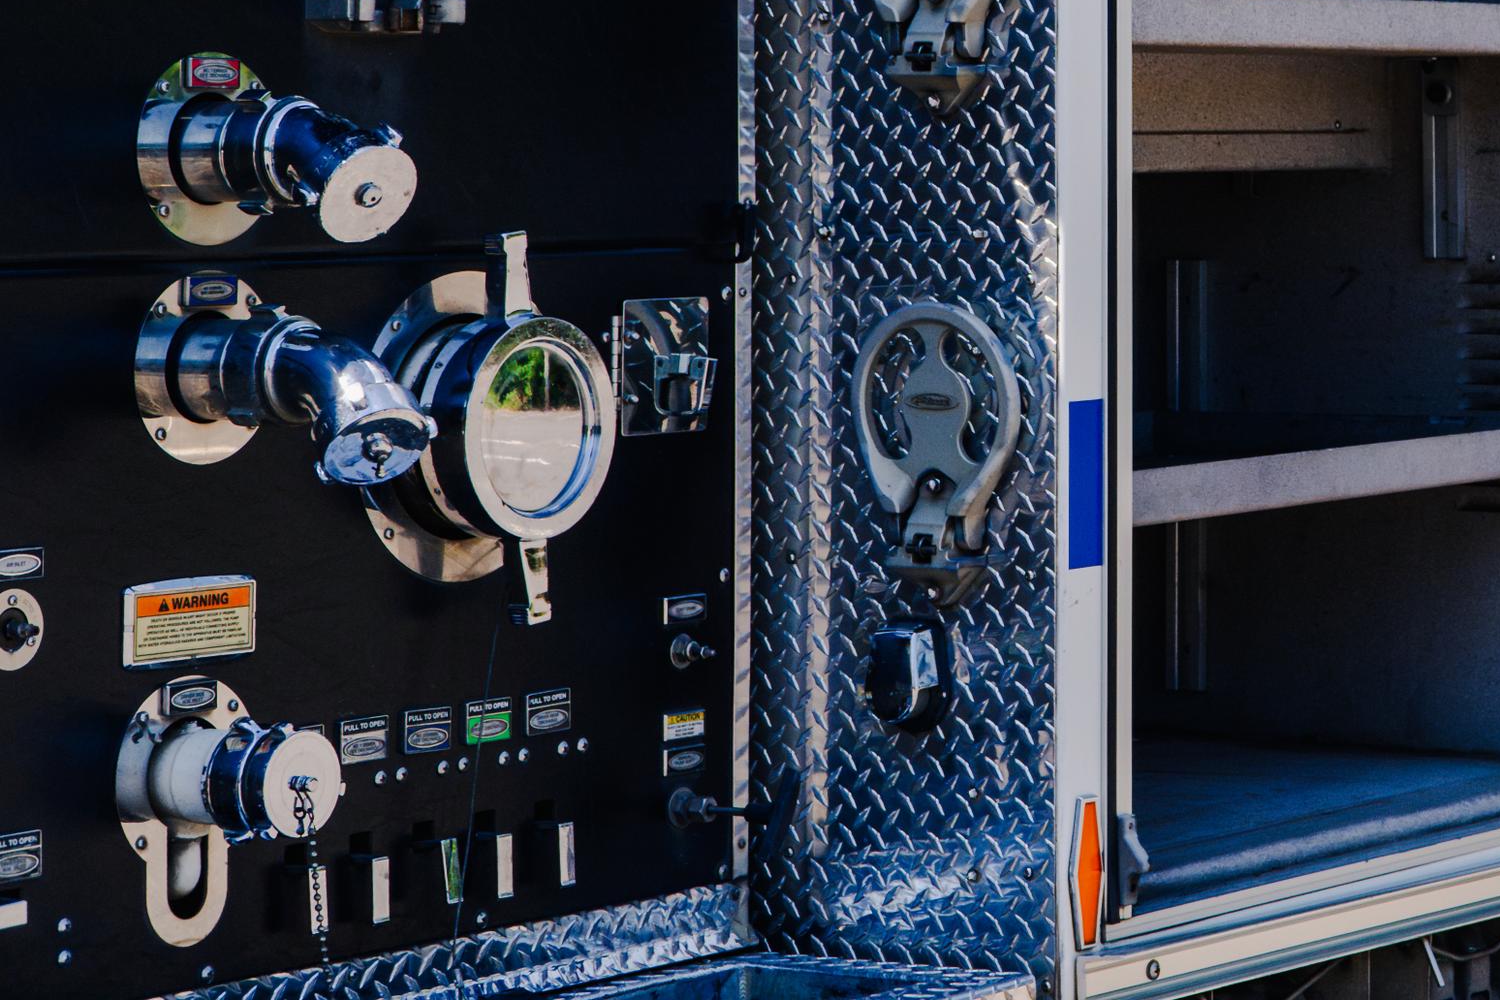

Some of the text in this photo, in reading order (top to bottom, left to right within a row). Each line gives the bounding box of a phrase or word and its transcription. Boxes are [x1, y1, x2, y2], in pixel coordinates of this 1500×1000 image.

[172, 592, 229, 610] WARNING
[551, 692, 567, 700] OPEN
[493, 700, 509, 709] OPEN
[408, 714, 423, 722] PULL
[432, 711, 448, 719] OPEN
[676, 713, 700, 723] CAUTION
[344, 724, 360, 732] PULL
[369, 719, 386, 728] OPEN
[8, 838, 18, 847] TO
